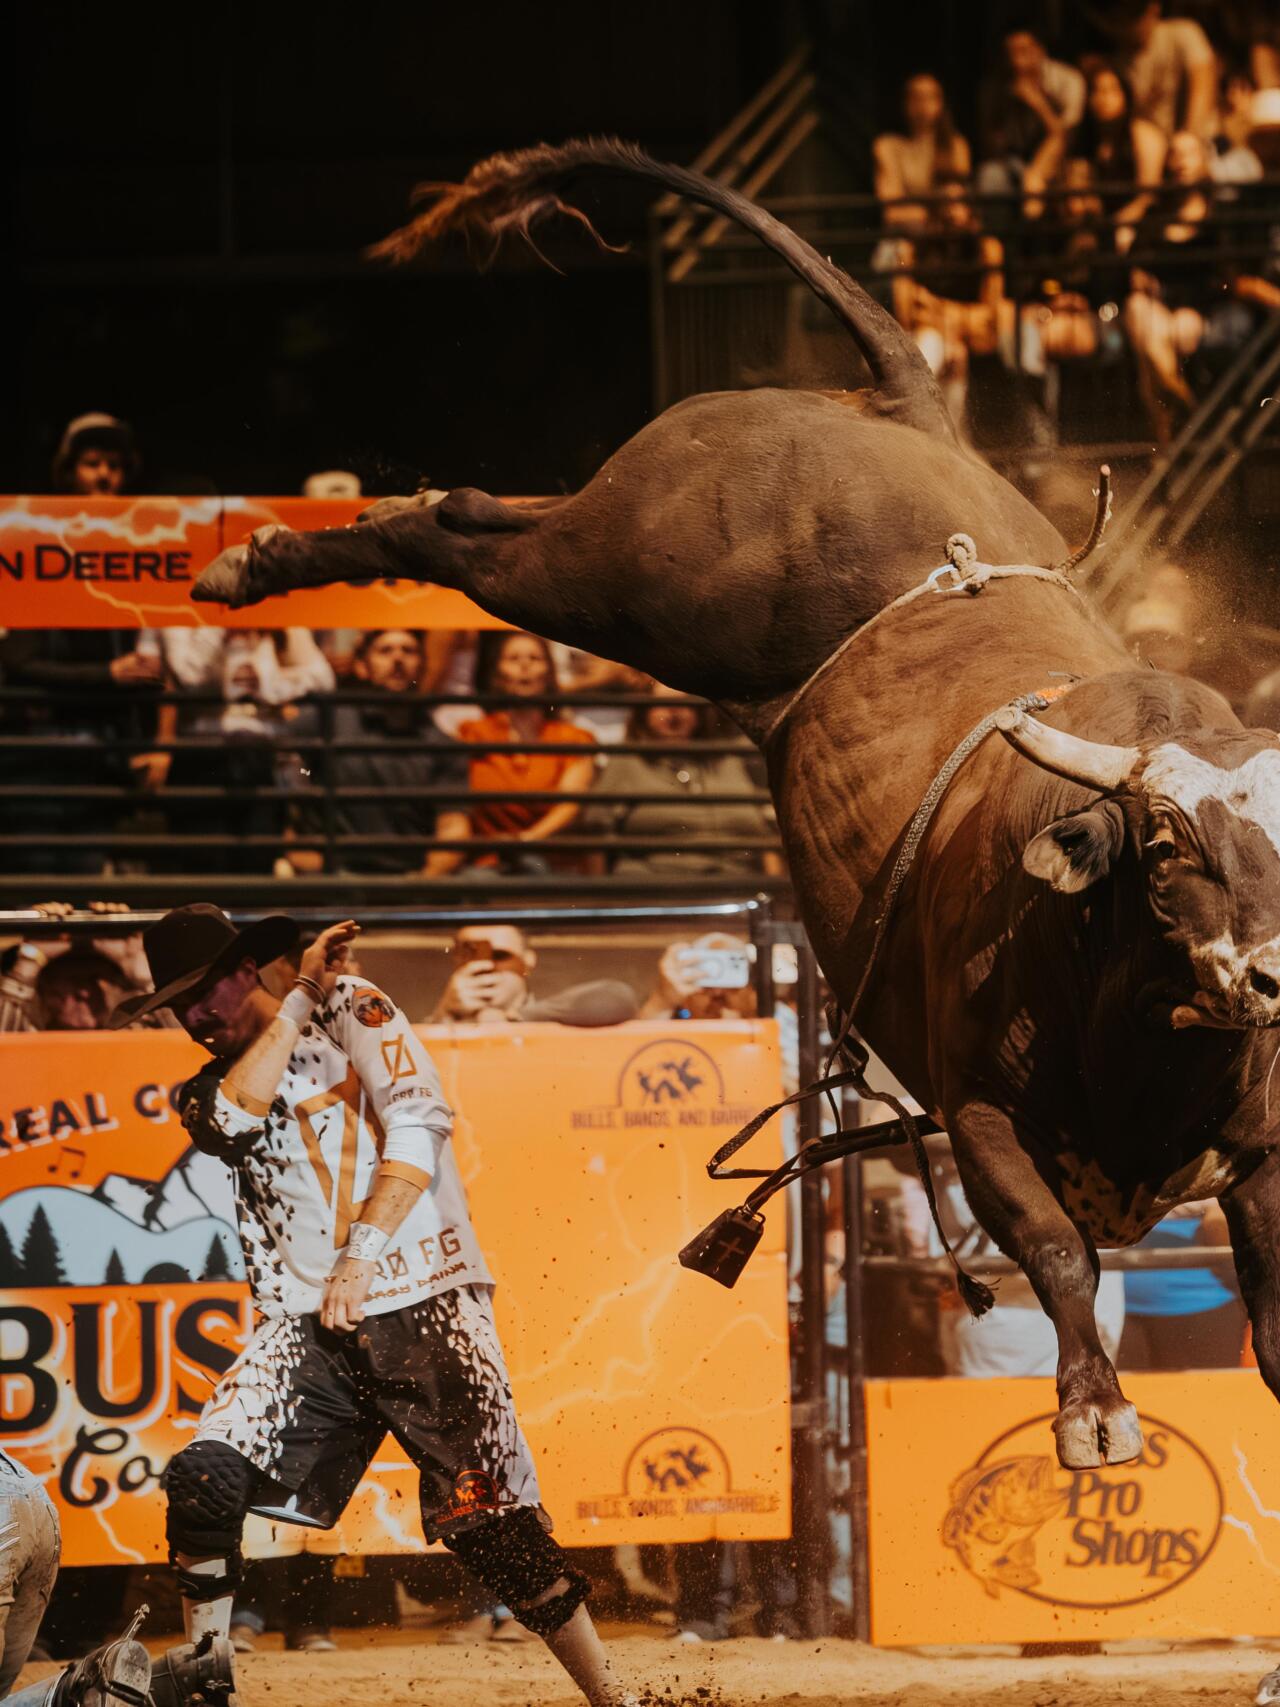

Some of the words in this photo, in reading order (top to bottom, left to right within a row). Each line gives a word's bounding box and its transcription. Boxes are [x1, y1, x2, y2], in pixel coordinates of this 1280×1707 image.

[34, 544, 192, 582] DEERE
[418, 1227, 462, 1265] FG
[1064, 1469, 1142, 1518] Pro
[1065, 1517, 1200, 1578] Shops
